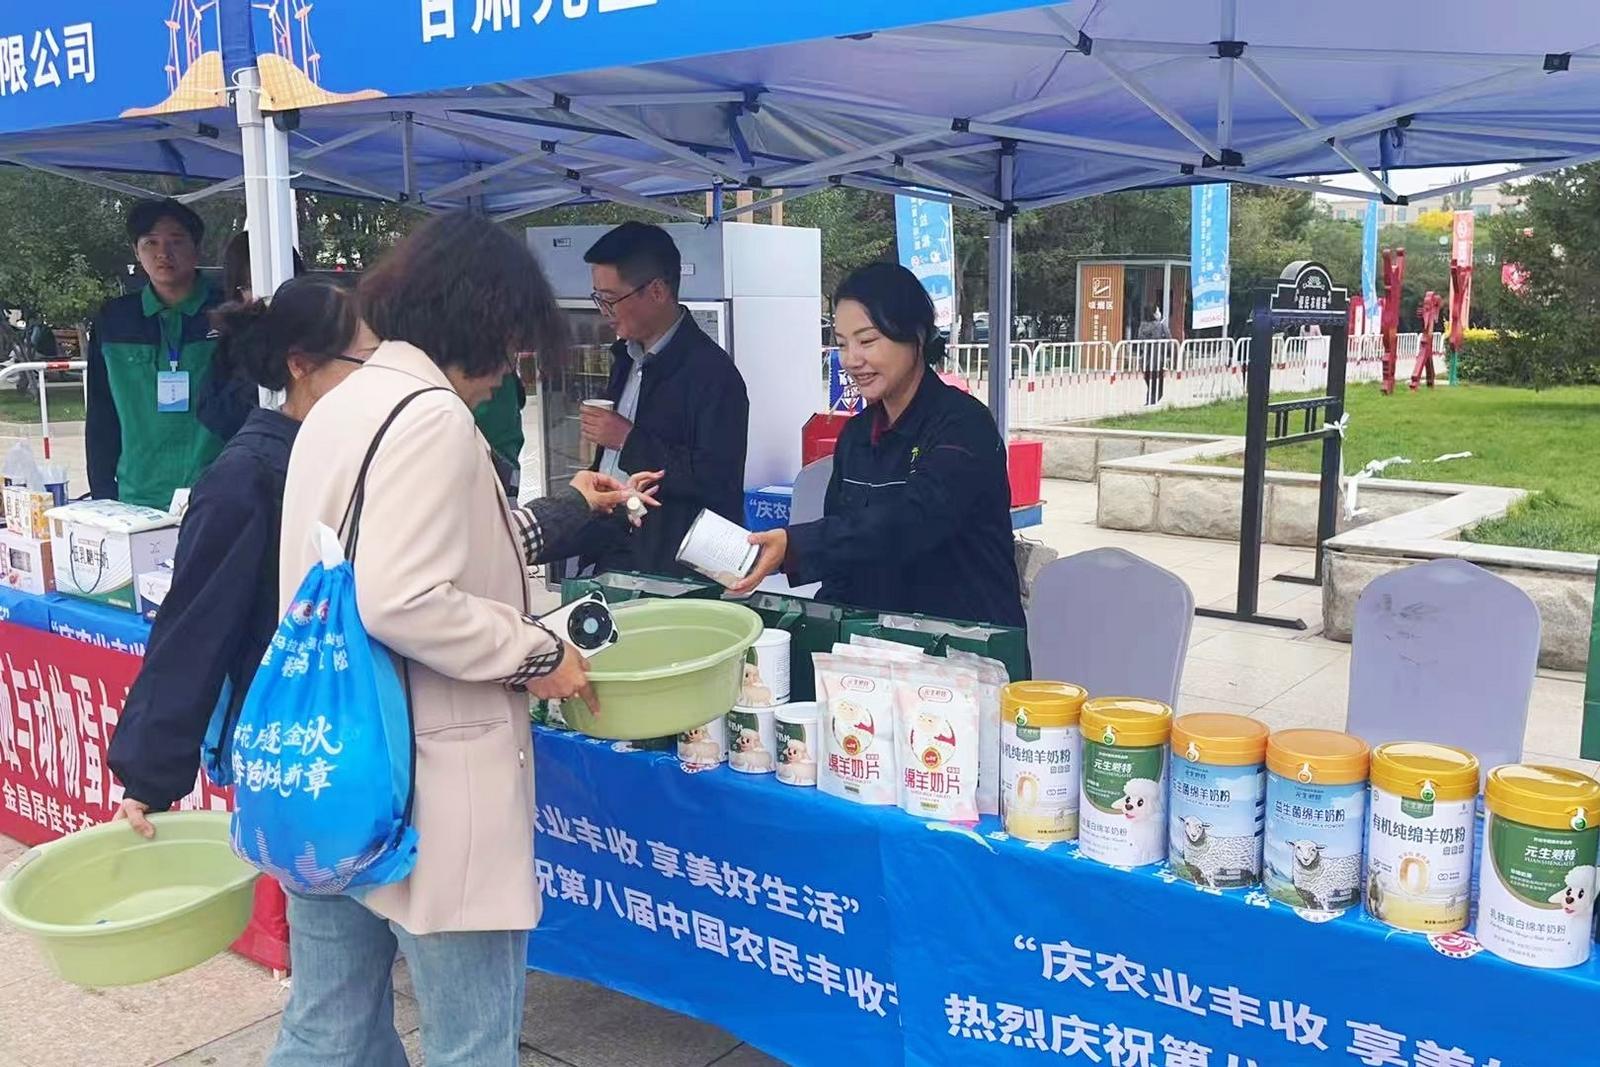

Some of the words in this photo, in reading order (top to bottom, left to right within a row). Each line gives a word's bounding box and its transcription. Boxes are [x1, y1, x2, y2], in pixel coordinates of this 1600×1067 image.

[0, 22, 96, 97] 限公司
[749, 499, 791, 520] “庆农
[828, 752, 880, 780] 绵羊奶片
[905, 767, 961, 795] 绵羊奶片
[1372, 813, 1466, 844] 有机纯绵羊奶粉
[1013, 934, 1328, 1051] “庆农业丰收
[1346, 1019, 1500, 1067] 享美
[944, 993, 1257, 1067] 热烈庆祝第
